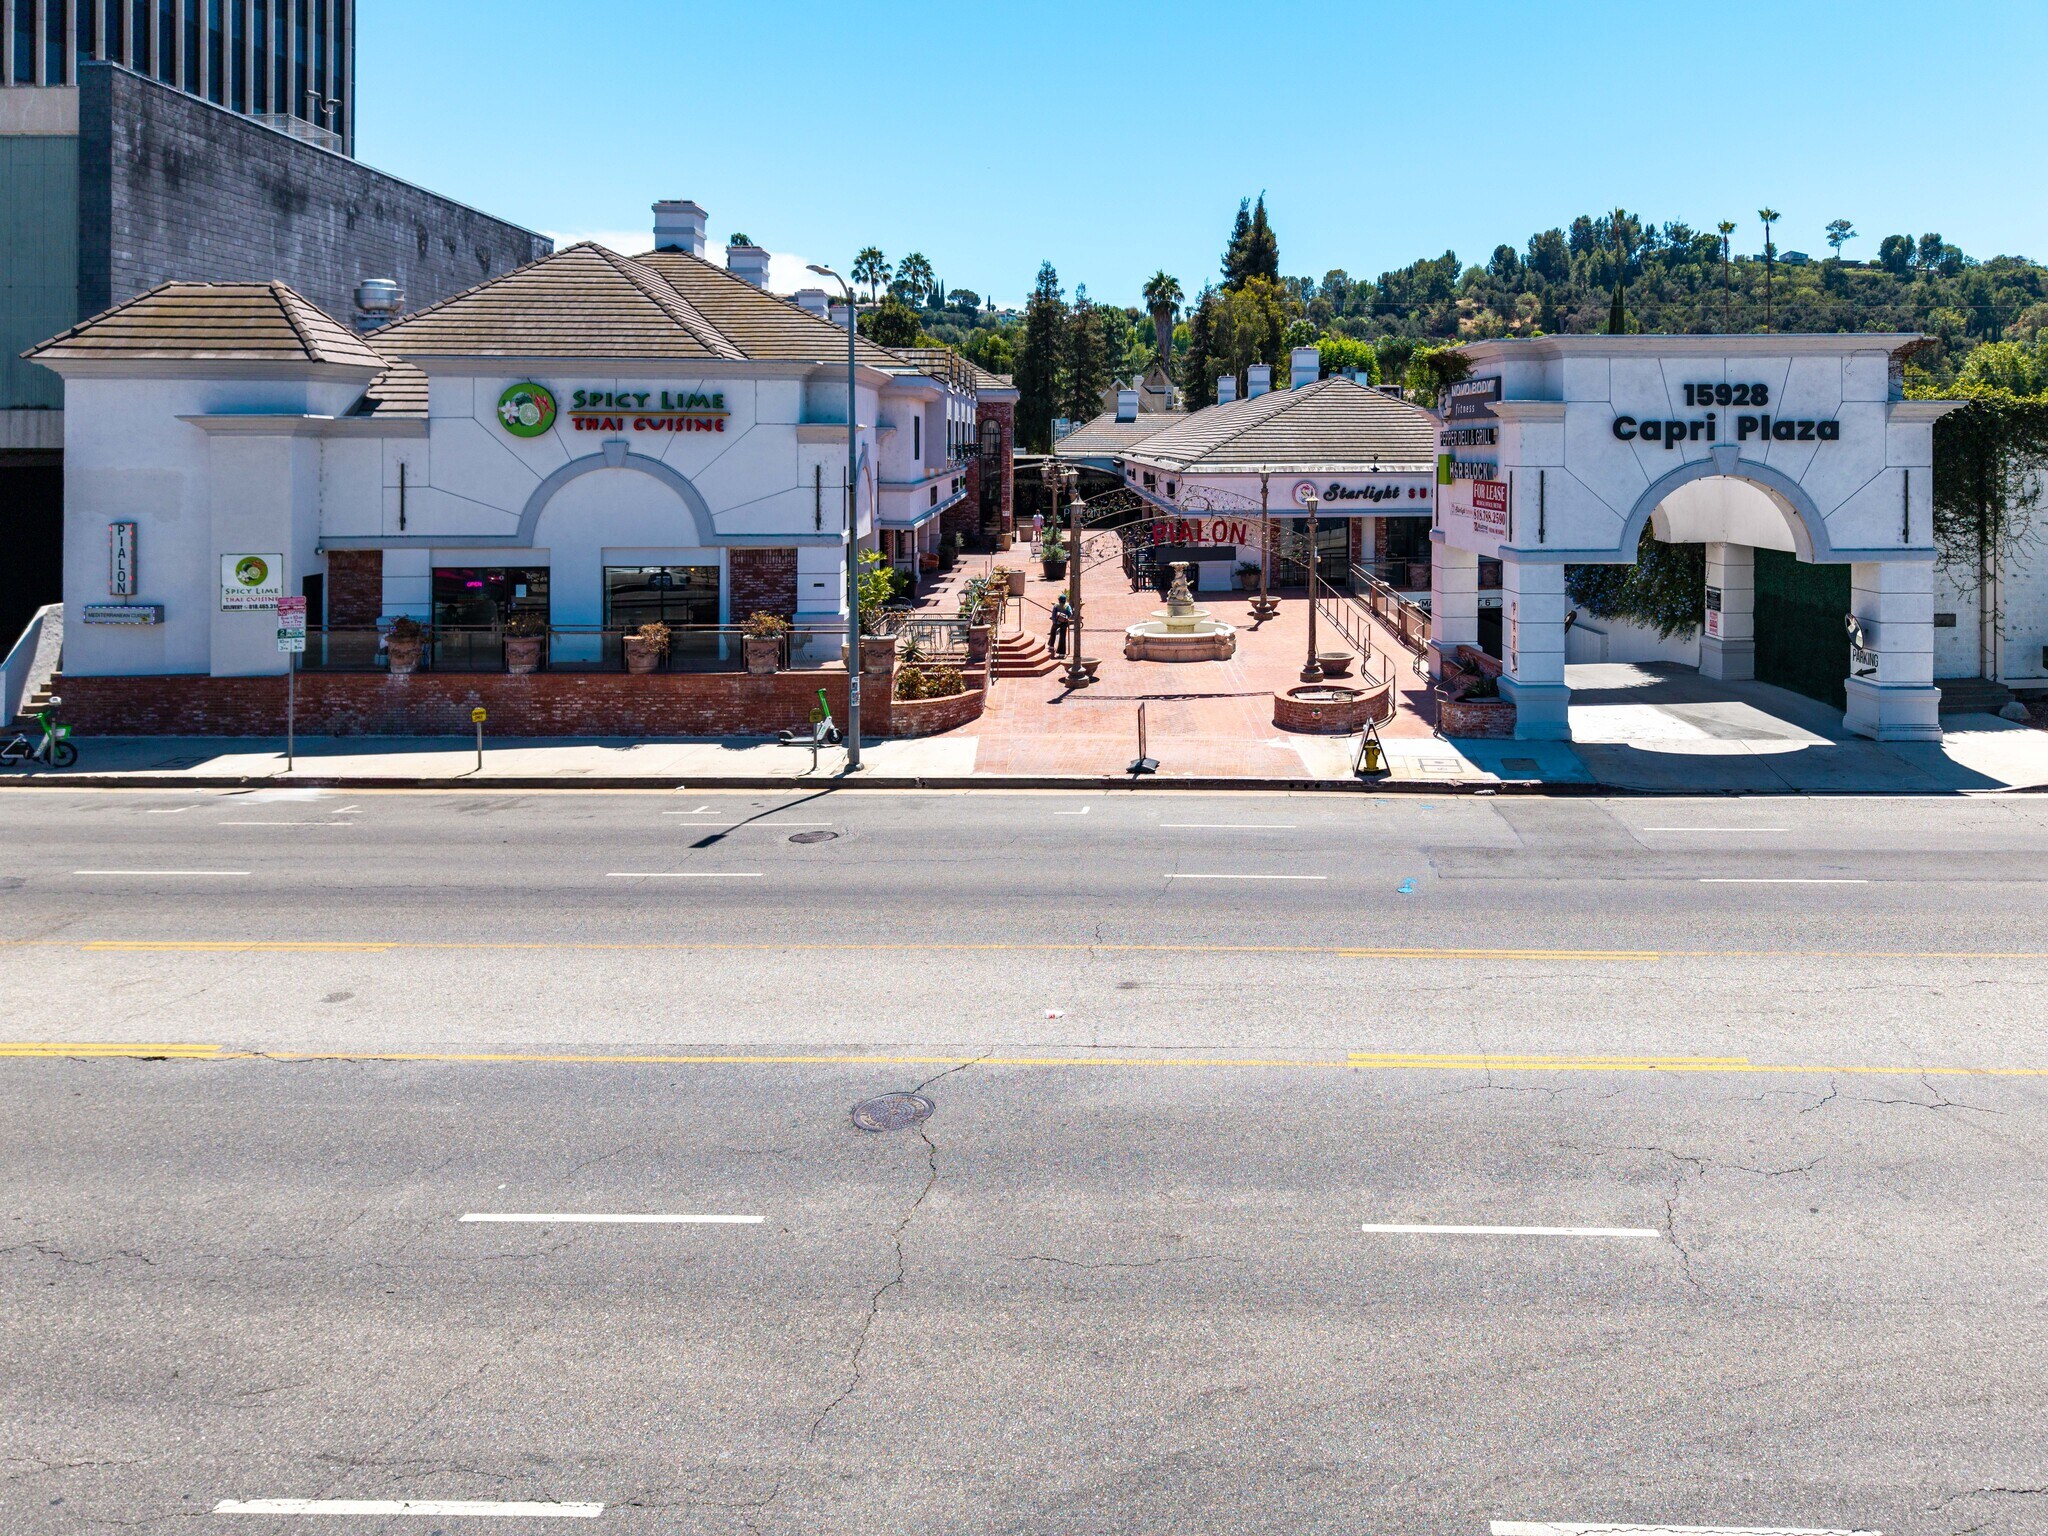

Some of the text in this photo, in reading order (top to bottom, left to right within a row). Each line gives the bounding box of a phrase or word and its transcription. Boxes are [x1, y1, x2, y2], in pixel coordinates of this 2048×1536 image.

[1451, 380, 1496, 397] NOVO BODY
[1684, 384, 1769, 407] 15928
[572, 390, 725, 410] SPICY LIME
[1455, 403, 1475, 416] fitness
[572, 417, 725, 432] THAI CUISINE
[1612, 412, 1840, 450] Capri Plaza
[1440, 429, 1491, 446] PEPPER DELI & GRILL
[1450, 462, 1488, 480] H&R BLOCK
[1322, 483, 1434, 503] Starlight SU
[1474, 483, 1505, 502] FOR LEASE
[1152, 520, 1247, 546] PIALON
[117, 524, 126, 594] PIALON
[1852, 648, 1878, 668] PARKING
